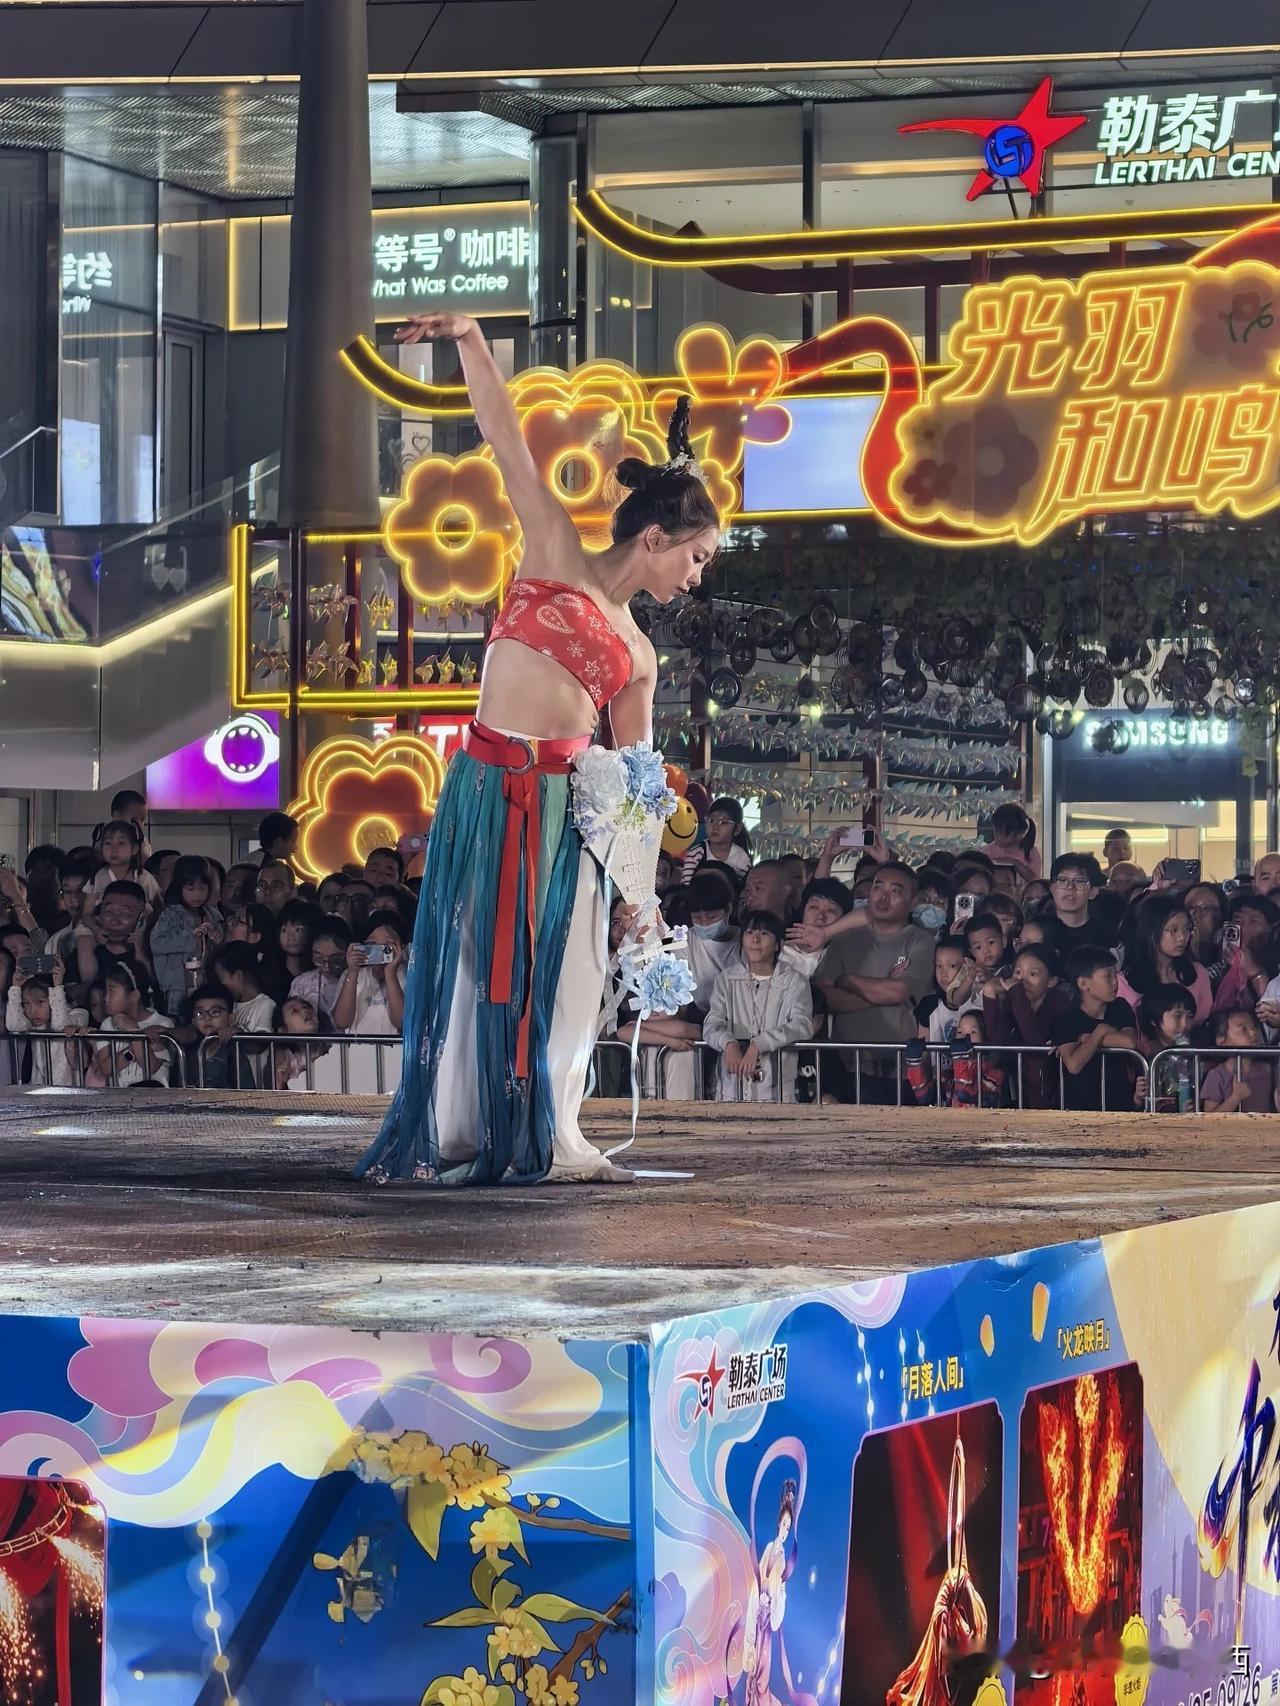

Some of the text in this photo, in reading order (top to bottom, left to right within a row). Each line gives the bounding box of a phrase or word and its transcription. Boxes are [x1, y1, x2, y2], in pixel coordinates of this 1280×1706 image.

[1097, 90, 1280, 157] 勒泰广
[1094, 157, 1217, 185] LERTHAI
[412, 276, 446, 295] Was
[451, 273, 509, 292] Coffee
[943, 281, 1186, 400] 光羽
[1024, 384, 1280, 533] 和鸣
[728, 1346, 787, 1393] 勒泰广场
[727, 1383, 786, 1410] LERTHAI CENTER
